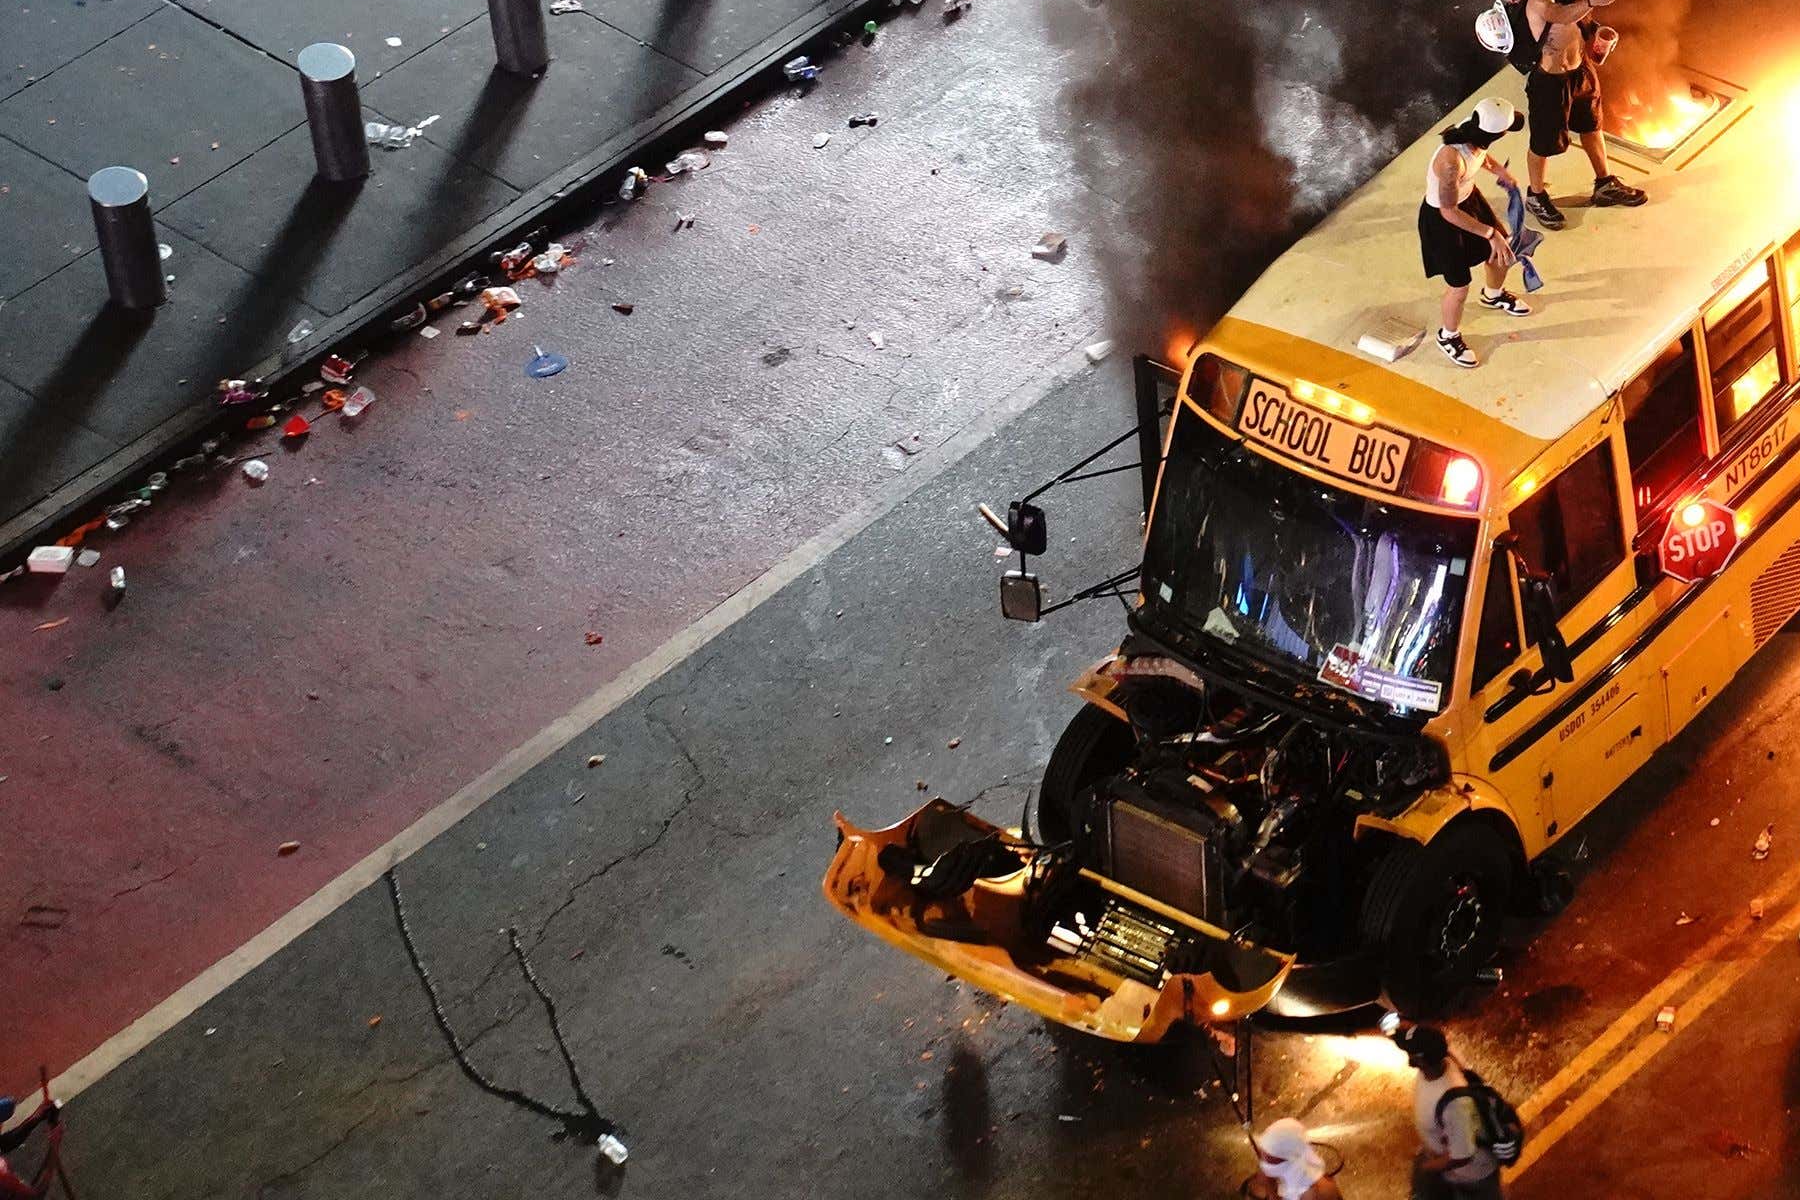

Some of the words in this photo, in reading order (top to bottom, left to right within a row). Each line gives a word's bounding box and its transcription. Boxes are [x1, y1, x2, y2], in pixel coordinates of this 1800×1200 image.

[1245, 390, 1333, 464] SCHOOL
[1347, 434, 1401, 485] BUS
[1725, 417, 1789, 492] NT8617
[1668, 519, 1727, 563] STOP
[1558, 711, 1586, 743] USDOT
